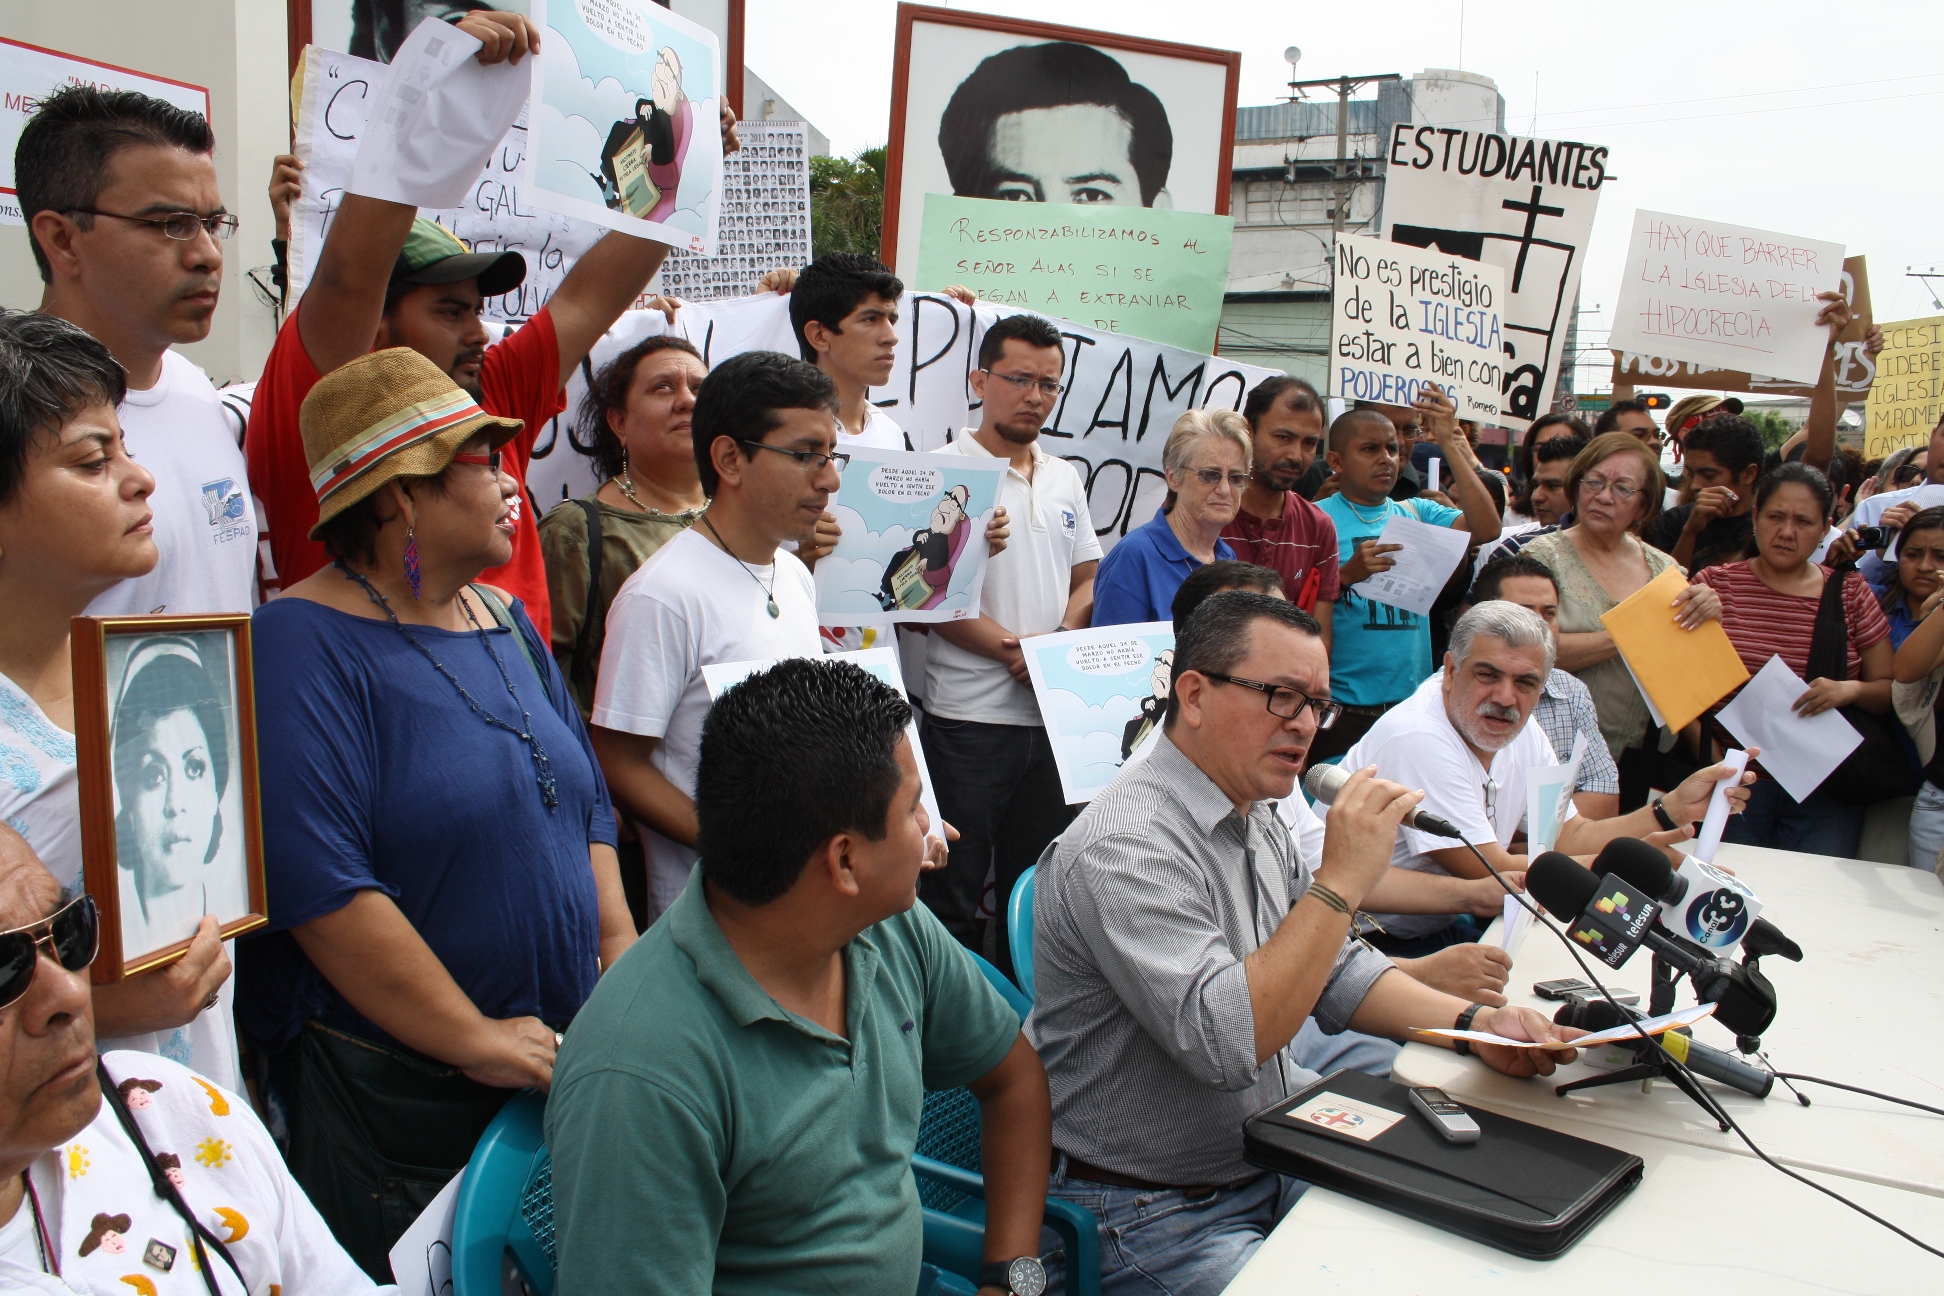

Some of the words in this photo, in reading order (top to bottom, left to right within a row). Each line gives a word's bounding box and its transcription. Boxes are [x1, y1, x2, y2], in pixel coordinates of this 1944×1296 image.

[582, 4, 604, 20] VUELTO
[636, 32, 646, 42] ESE
[586, 16, 604, 30] DOLOR
[606, 26, 614, 36] EN
[618, 32, 624, 40] EL
[1391, 124, 1609, 191] ESTUDIANTES
[1183, 238, 1207, 254] AL
[1644, 220, 1692, 261] HAY
[1696, 231, 1732, 259] QUE
[1739, 238, 1819, 275] BARRER
[955, 259, 1018, 275] SEÑOR
[1029, 257, 1075, 276] ALAS
[1096, 264, 1117, 277] SI
[1133, 268, 1155, 282] SE
[1377, 258, 1402, 288] es
[1410, 261, 1493, 308] prestigio
[1641, 259, 1671, 286] LA
[1766, 279, 1799, 300] DE
[1046, 289, 1060, 304] A
[1080, 291, 1192, 311] EXTRAVIAR
[1094, 319, 1121, 333] DE
[1344, 285, 1373, 324] de
[1389, 289, 1411, 331] la
[1418, 300, 1503, 353] IGLESIA
[1338, 329, 1398, 366] estar
[1405, 342, 1422, 370] a
[1431, 340, 1464, 382] bien
[1468, 359, 1501, 392] con
[1467, 395, 1498, 417] Romero
[214, 526, 250, 545] FESPAD
[1702, 888, 1744, 932] 33
[1700, 919, 1719, 944] Canal
